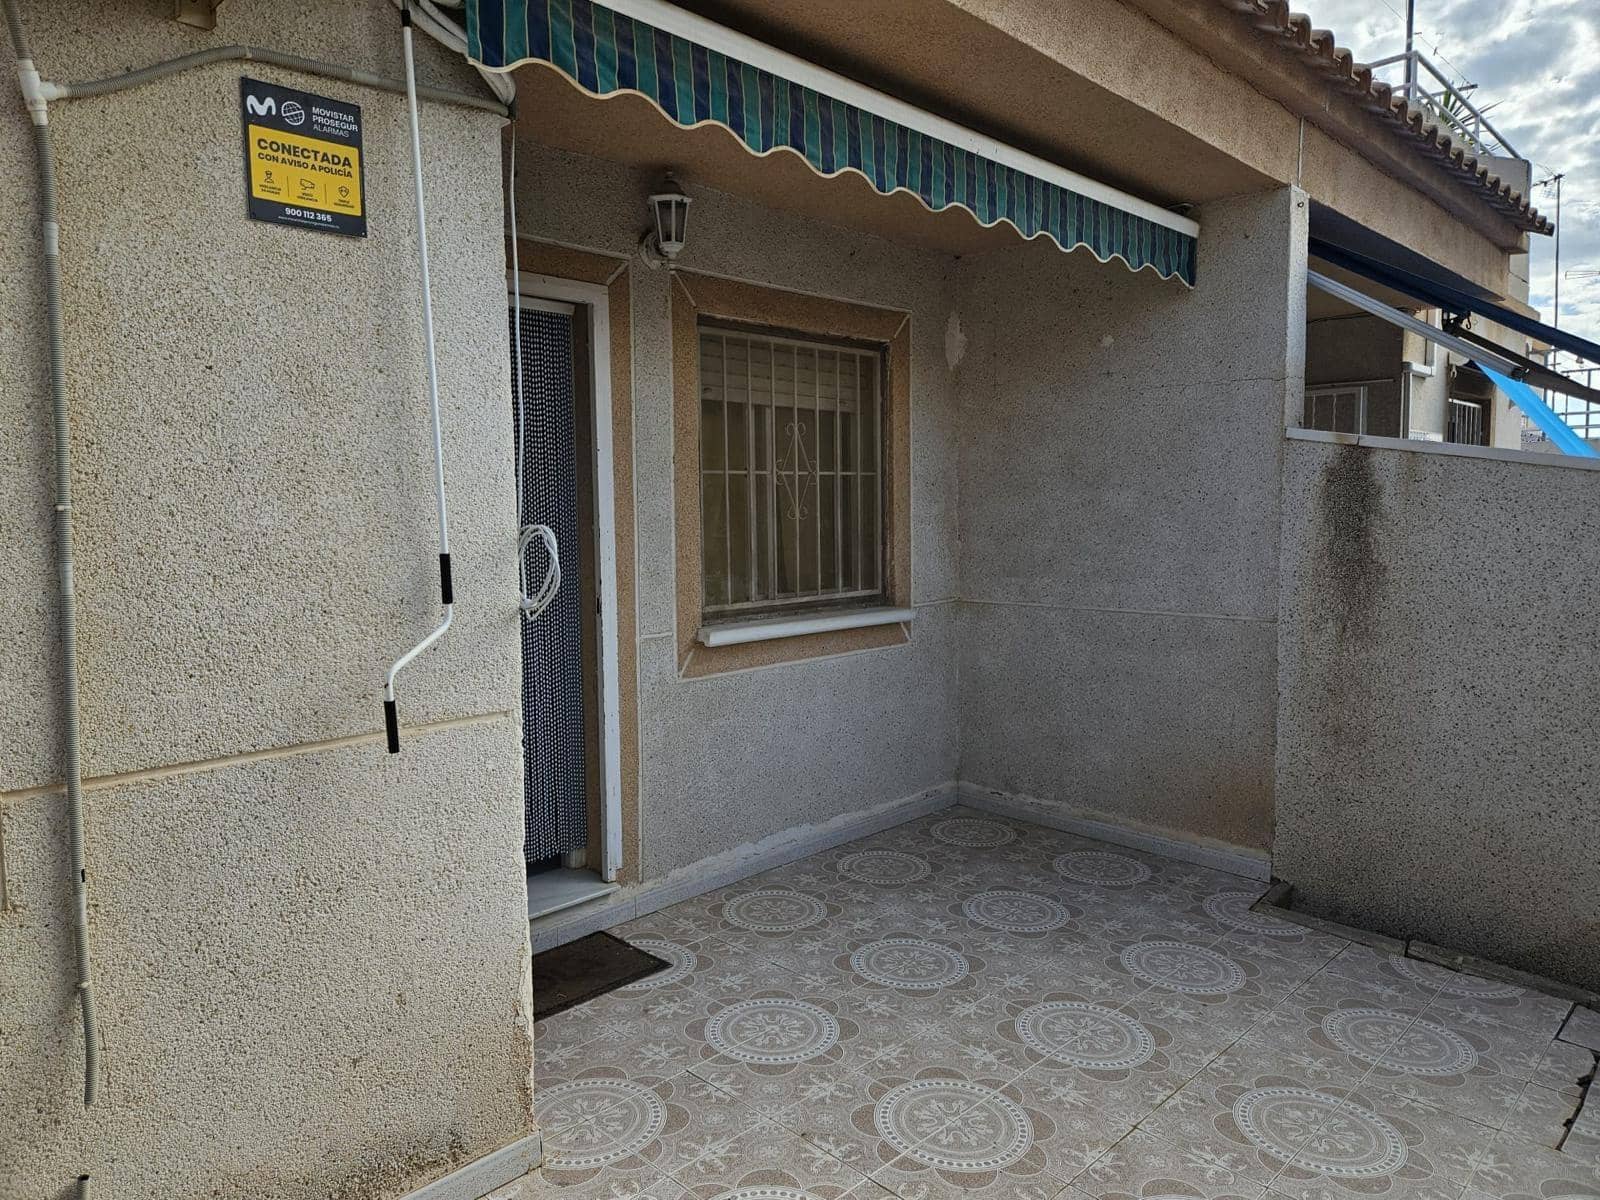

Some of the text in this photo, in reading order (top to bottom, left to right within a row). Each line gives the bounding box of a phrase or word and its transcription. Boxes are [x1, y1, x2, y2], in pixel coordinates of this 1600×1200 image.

[312, 107, 354, 122] MOVISTAR
[312, 115, 358, 132] PROSEGUR
[313, 124, 350, 138] ALARMAS
[257, 138, 353, 168] CONECTADA
[258, 152, 353, 178] CON AVISO A POLICÍA
[285, 207, 302, 217] 900
[303, 211, 315, 220] 112
[316, 213, 332, 222] 365
